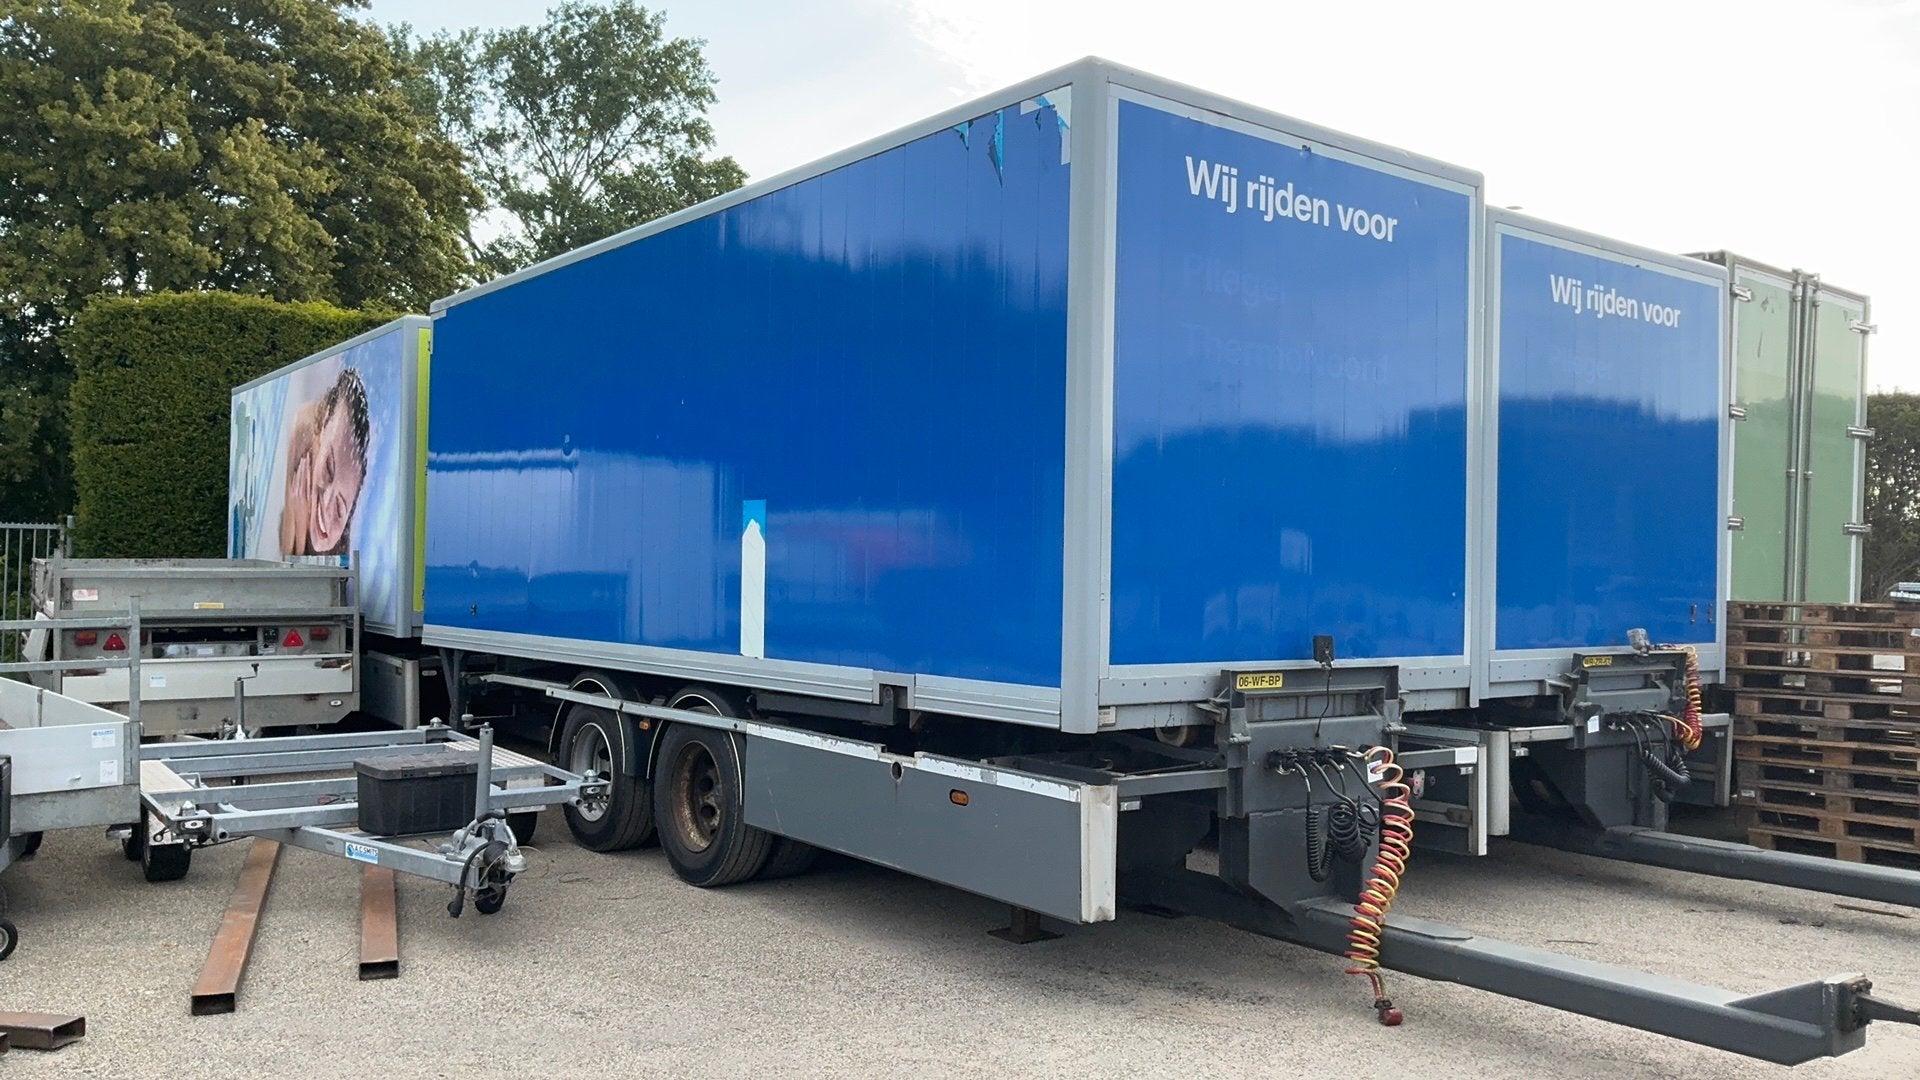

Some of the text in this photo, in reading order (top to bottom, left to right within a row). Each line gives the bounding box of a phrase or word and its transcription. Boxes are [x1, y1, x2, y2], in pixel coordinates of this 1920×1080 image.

[1185, 156, 1398, 242] Wij rijden voor
[1550, 274, 1681, 328] Wij rijden voor
[1239, 675, 1281, 687] 06-WF-BP
